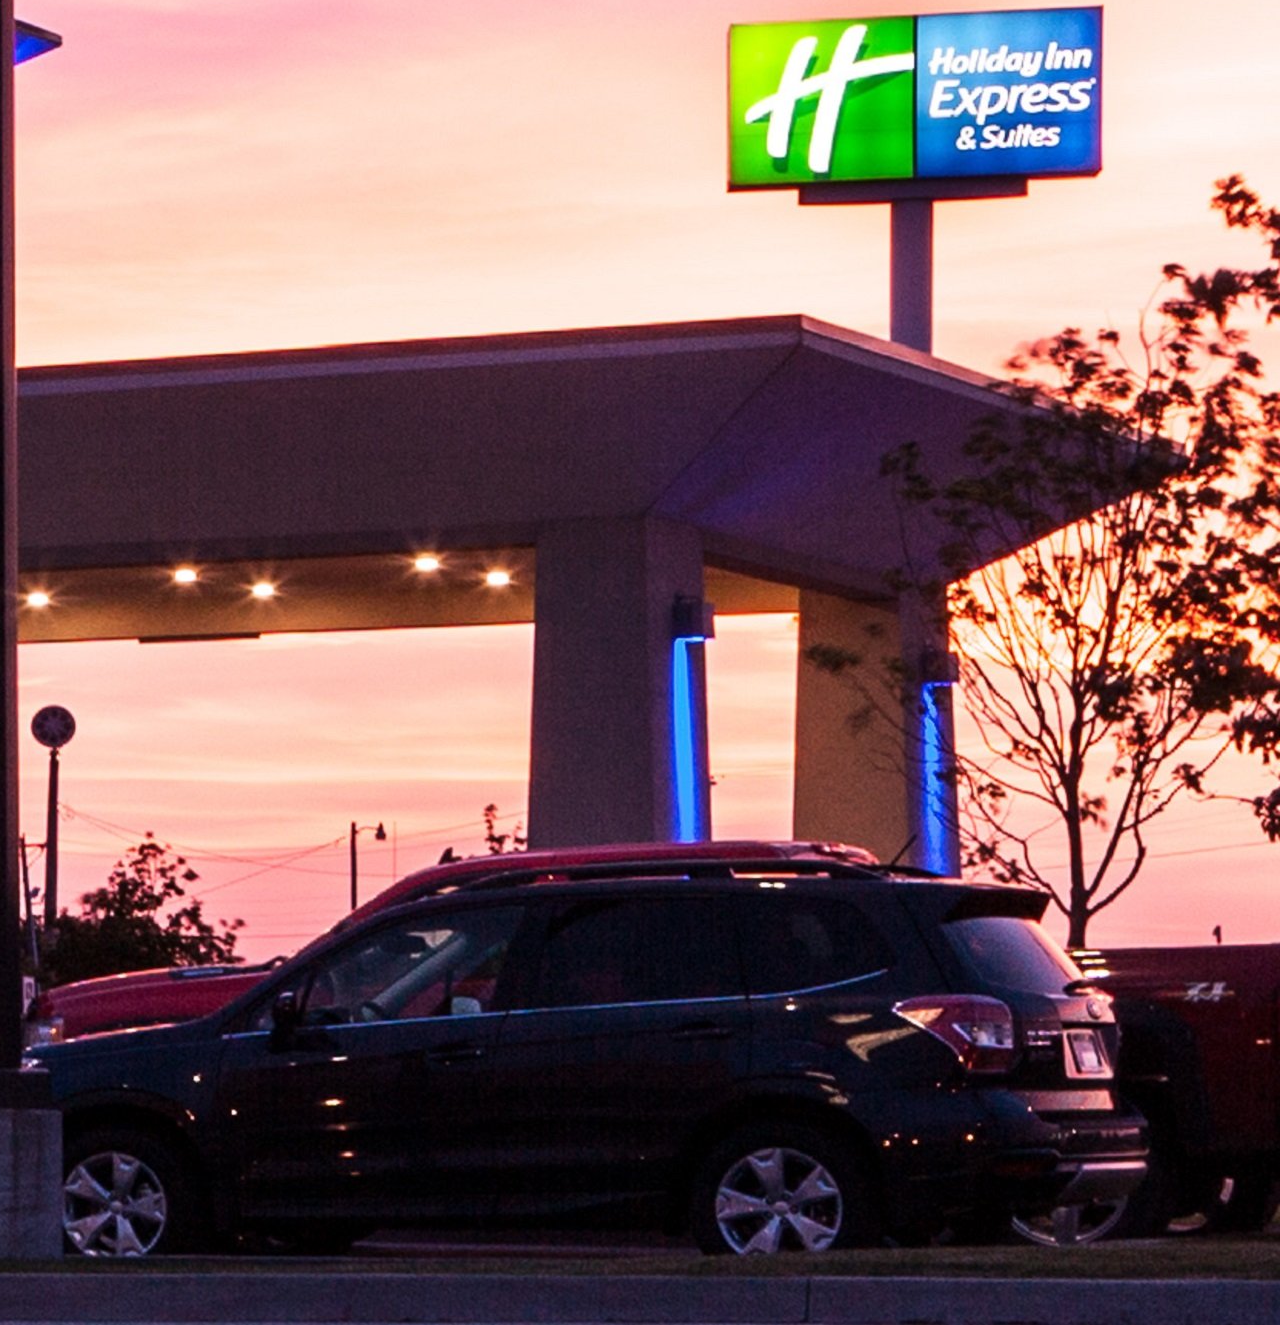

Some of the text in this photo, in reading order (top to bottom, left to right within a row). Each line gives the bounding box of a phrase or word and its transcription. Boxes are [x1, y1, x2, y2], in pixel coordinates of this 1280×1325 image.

[928, 41, 1093, 77] Holiday Inn
[928, 79, 1093, 126] Express
[955, 123, 1062, 151] & Suites
